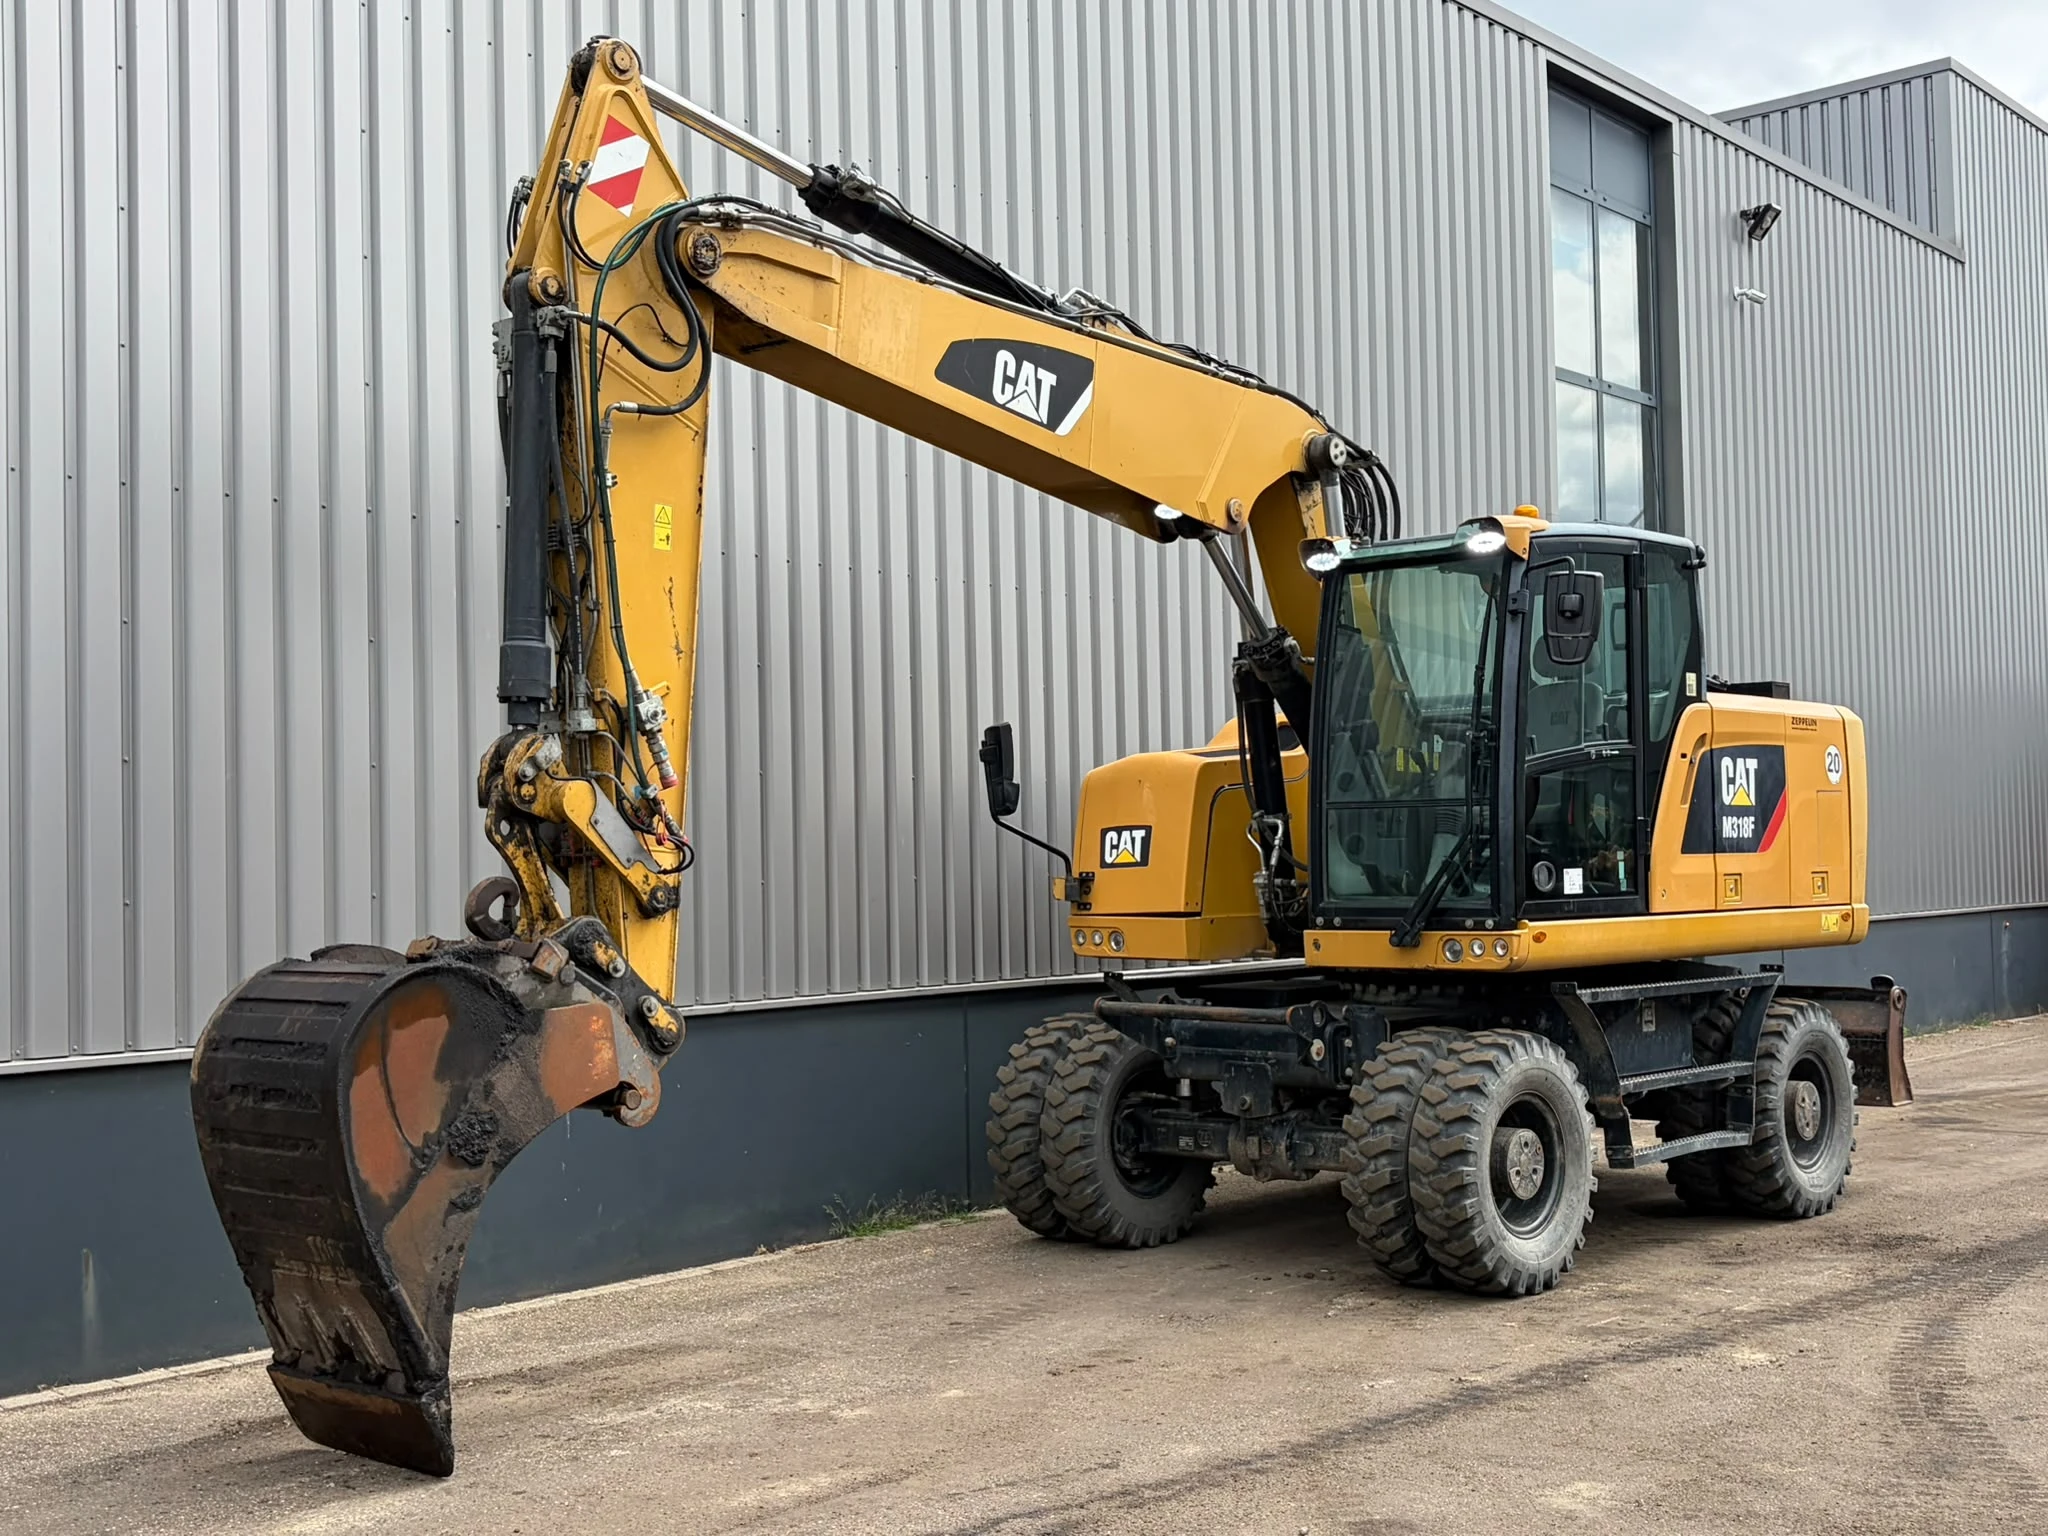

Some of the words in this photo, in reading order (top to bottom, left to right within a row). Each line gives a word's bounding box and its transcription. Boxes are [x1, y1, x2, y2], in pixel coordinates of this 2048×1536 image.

[992, 349, 1058, 425] CAT
[1791, 716, 1817, 726] ZEPPELIN
[1826, 751, 1840, 774] 20
[1720, 756, 1758, 806] CAT
[1722, 815, 1755, 839] M318F
[1104, 829, 1146, 864] CAT
